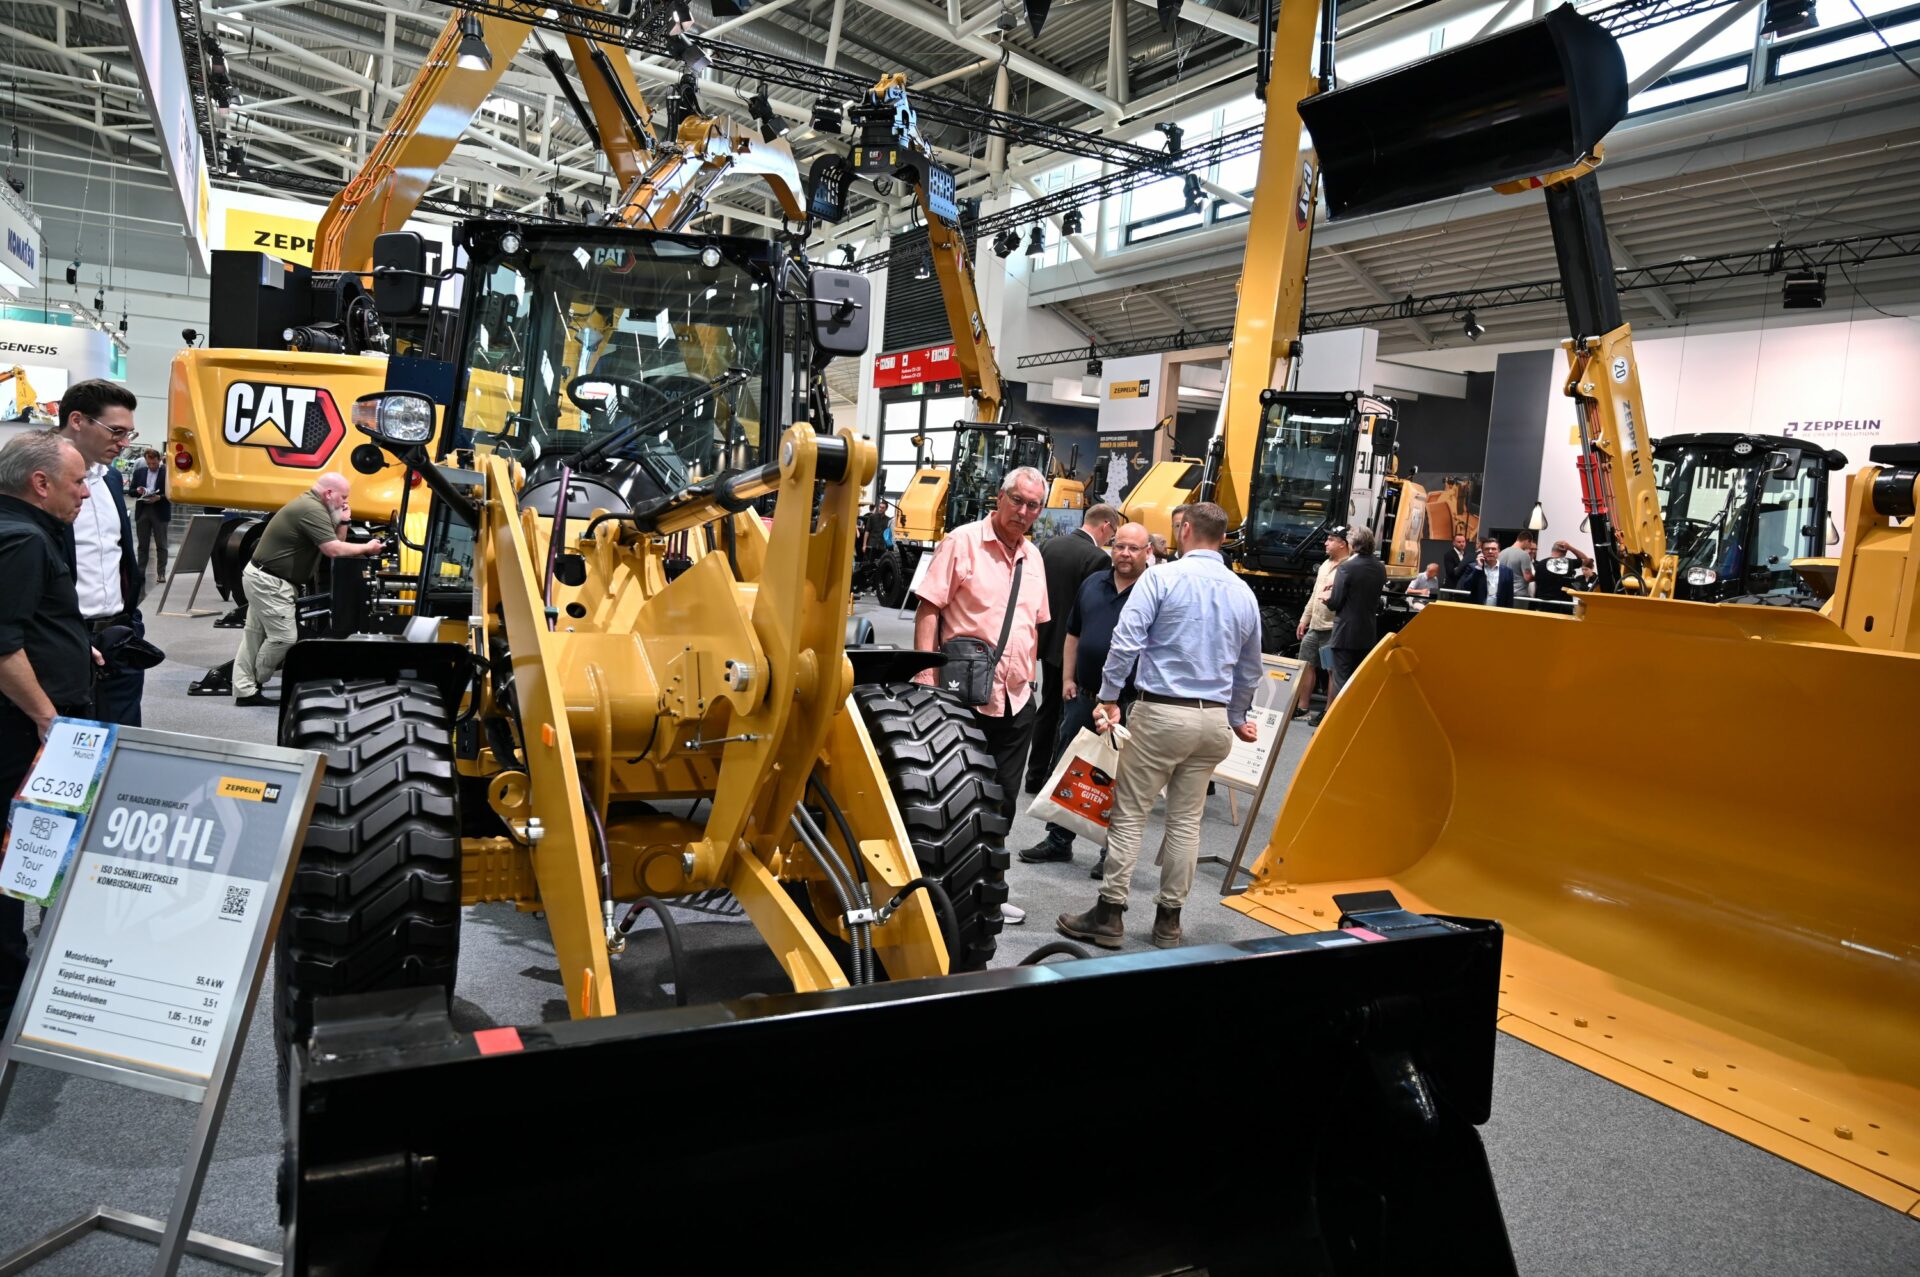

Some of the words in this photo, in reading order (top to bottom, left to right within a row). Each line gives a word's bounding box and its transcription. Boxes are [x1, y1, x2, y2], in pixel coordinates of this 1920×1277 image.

[1299, 161, 1312, 219] CAT
[8, 227, 34, 270] KOMATSU
[594, 247, 625, 267] CAT
[0, 342, 58, 356] GENESIS
[1614, 361, 1626, 379] 20
[224, 382, 316, 448] CAT
[1803, 419, 1880, 432] ZEPPELIN
[1623, 400, 1642, 477] ZEPPELIN
[72, 732, 100, 748] IFAT
[74, 750, 95, 760] Munich
[31, 776, 84, 799] C5.238
[225, 784, 261, 794] ZEPPELIN
[264, 788, 279, 799] CAT
[117, 793, 129, 801] CAT
[129, 795, 161, 806] RADLADER
[161, 800, 190, 811] HIGHLIFT
[1081, 790, 1104, 805] GUTEN
[103, 807, 169, 854] 908
[167, 815, 215, 864] HL
[15, 838, 58, 859] Solution
[22, 856, 43, 872] Tour
[14, 873, 37, 889] Stop
[101, 865, 112, 874] ISO
[113, 867, 179, 885] SCHNELLWECHSLER
[97, 877, 153, 893] KOMBISCHAUFEL
[87, 975, 116, 987] geknickt
[211, 979, 224, 989] kW
[51, 986, 108, 1005] Schaufelvolumen
[45, 1005, 95, 1023] Einsatzgewicht
